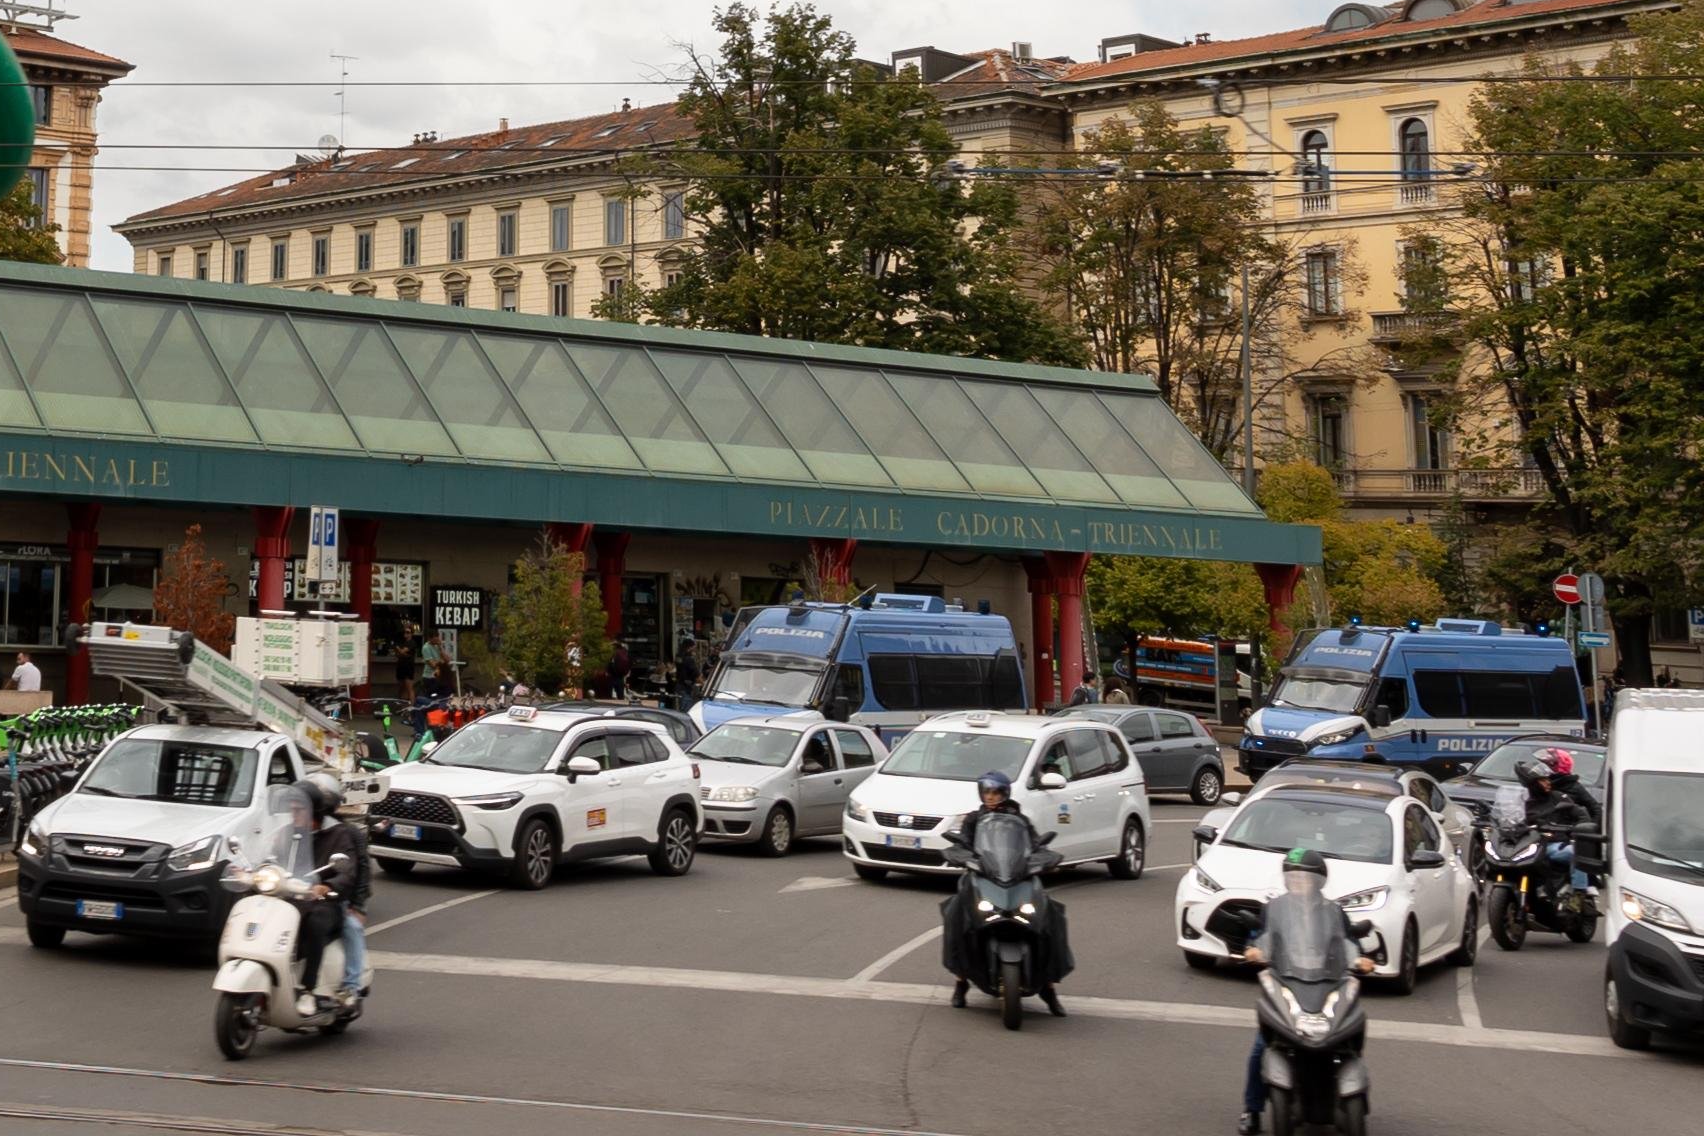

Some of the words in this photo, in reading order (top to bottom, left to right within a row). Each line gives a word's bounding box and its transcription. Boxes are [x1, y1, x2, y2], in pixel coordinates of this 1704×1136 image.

[326, 516, 335, 543] P
[769, 500, 903, 532] PIAZZALE
[936, 511, 1065, 543] CADORNA
[1088, 520, 1224, 551] TRIENNALE
[436, 590, 480, 605] TURKISH
[435, 606, 480, 626] KEBAP
[755, 627, 825, 639] POLIZIA
[1314, 646, 1372, 657] POLIZIA
